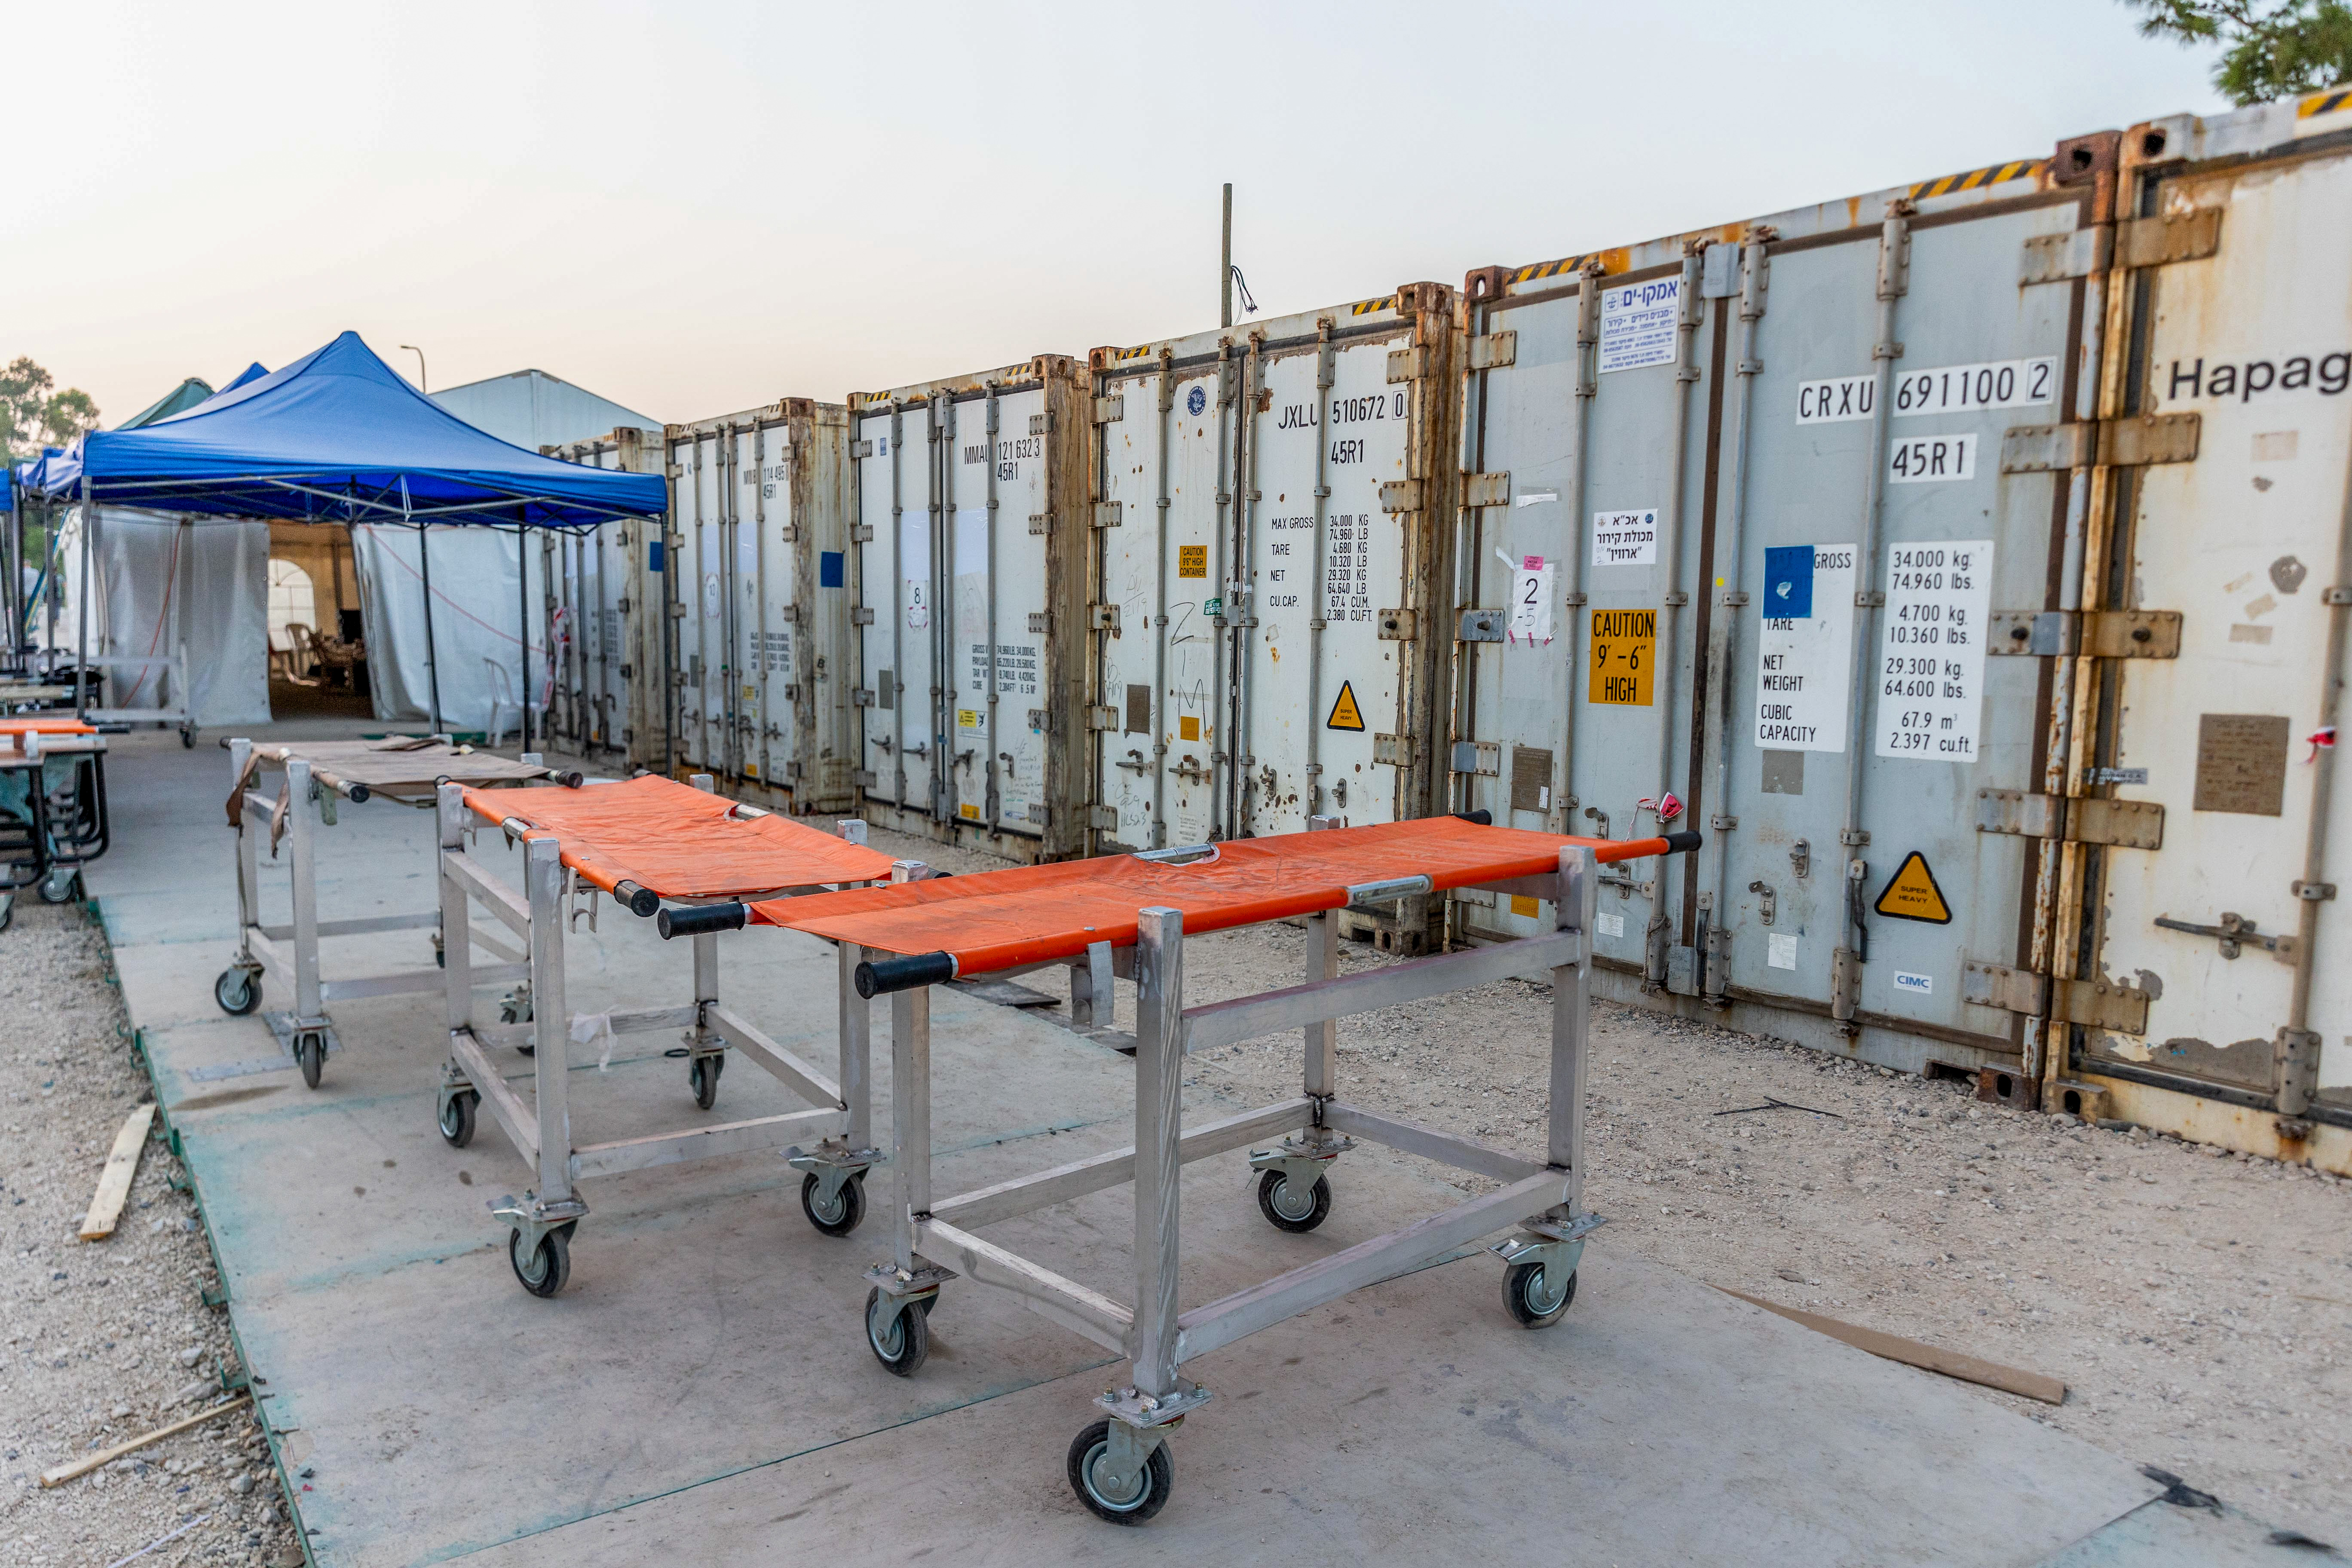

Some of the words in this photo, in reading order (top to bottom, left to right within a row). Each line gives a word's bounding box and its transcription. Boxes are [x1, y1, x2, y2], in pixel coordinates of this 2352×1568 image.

[1623, 281, 1678, 307] אמקו-ים
[1631, 314, 1648, 323] ניידים
[1650, 309, 1669, 320] מבנים
[1607, 318, 1623, 328] קירור
[2168, 351, 2352, 404] Hapag
[1800, 380, 1874, 418] CRXU
[1898, 367, 2014, 411] 691100
[2031, 364, 2049, 400] 2
[1333, 395, 1385, 424] 510672
[1395, 393, 1403, 417] 0
[998, 441, 1012, 460] 121
[1017, 439, 1032, 459] 632
[1035, 438, 1040, 456] 3
[1331, 439, 1363, 464] 45R1
[1892, 441, 1965, 477] 45R1
[998, 462, 1018, 481] 45R1
[764, 484, 776, 499] 45R1
[1272, 518, 1286, 529] MAX
[1290, 517, 1314, 529] GROSS
[1359, 514, 1368, 526] KG
[1358, 528, 1368, 540] LB
[1597, 533, 1621, 545] קירור
[1624, 530, 1653, 542] מכולת
[1183, 548, 1203, 556] CAUTION
[1272, 544, 1290, 555] TARE
[1358, 542, 1367, 553] KG
[1606, 546, 1642, 561] "ארווין"
[1192, 557, 1203, 566] HIGH
[1357, 556, 1367, 567] LB
[1814, 553, 1851, 569] GROSS
[1894, 551, 1944, 568] 34.000
[1953, 551, 1972, 571] kg.
[1180, 568, 1205, 576] CONTAINER
[1271, 570, 1285, 581] NET
[1357, 569, 1366, 581] KG
[1356, 583, 1366, 594] LB
[1893, 573, 1942, 590] 74.960
[1951, 573, 1975, 590] lbs.
[915, 588, 921, 603] 8
[1524, 578, 1538, 604] 2
[1270, 596, 1299, 607] CU.CAP.
[1331, 596, 1345, 608] 67.4
[1351, 596, 1369, 608] CU.M.
[1351, 609, 1372, 622] CU.FT.
[1899, 605, 1940, 622] 4.700
[1949, 605, 1968, 625] kg.
[1593, 612, 1654, 638] CAUTION
[1767, 617, 1794, 631] TARE
[1890, 627, 1938, 644] 10.360
[1947, 627, 1970, 644] lbs.
[972, 645, 985, 654] GROSS
[1764, 655, 1784, 671] NET
[1886, 658, 1936, 676] 29.300
[1945, 659, 1964, 680] kg.
[973, 681, 982, 690] CUBE
[1605, 677, 1637, 702] HIGH
[1763, 676, 1803, 692] WEIGHT
[1885, 680, 1934, 698] 64.600
[1943, 680, 1966, 699] lbs.
[1761, 704, 1792, 720] CUBIC
[1902, 711, 1932, 729] 67.9
[1760, 724, 1816, 742] CAPACITY
[1890, 732, 1930, 751] 2.397
[1939, 735, 1972, 753] cu.ft.
[1901, 886, 1927, 894] SUPER
[1899, 895, 1927, 903] HEAVY
[1897, 975, 1929, 988] CIMC
